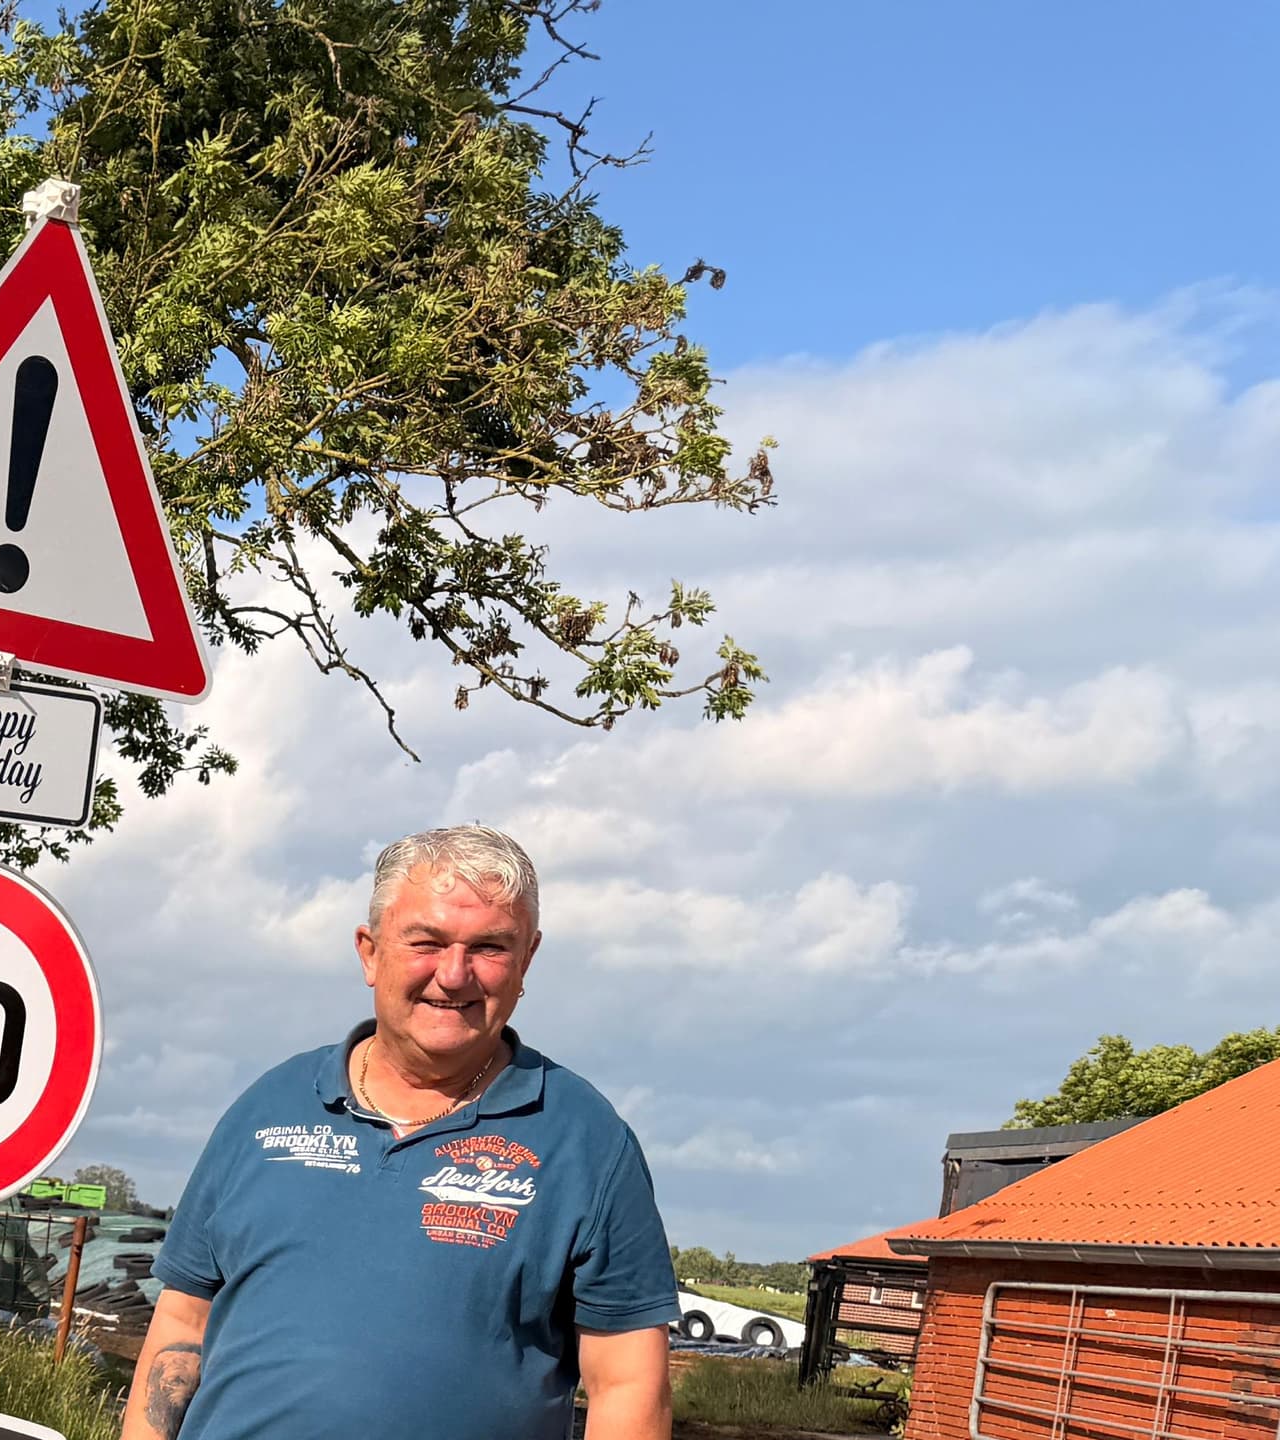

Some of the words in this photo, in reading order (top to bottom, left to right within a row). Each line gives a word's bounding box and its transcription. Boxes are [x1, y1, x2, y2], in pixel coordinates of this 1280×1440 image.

[255, 1125, 308, 1139] ORIGINAL
[263, 1134, 357, 1149] BROOKLYN
[421, 1203, 515, 1228] BROOKLYN
[421, 1215, 482, 1230] ORIGINAL
